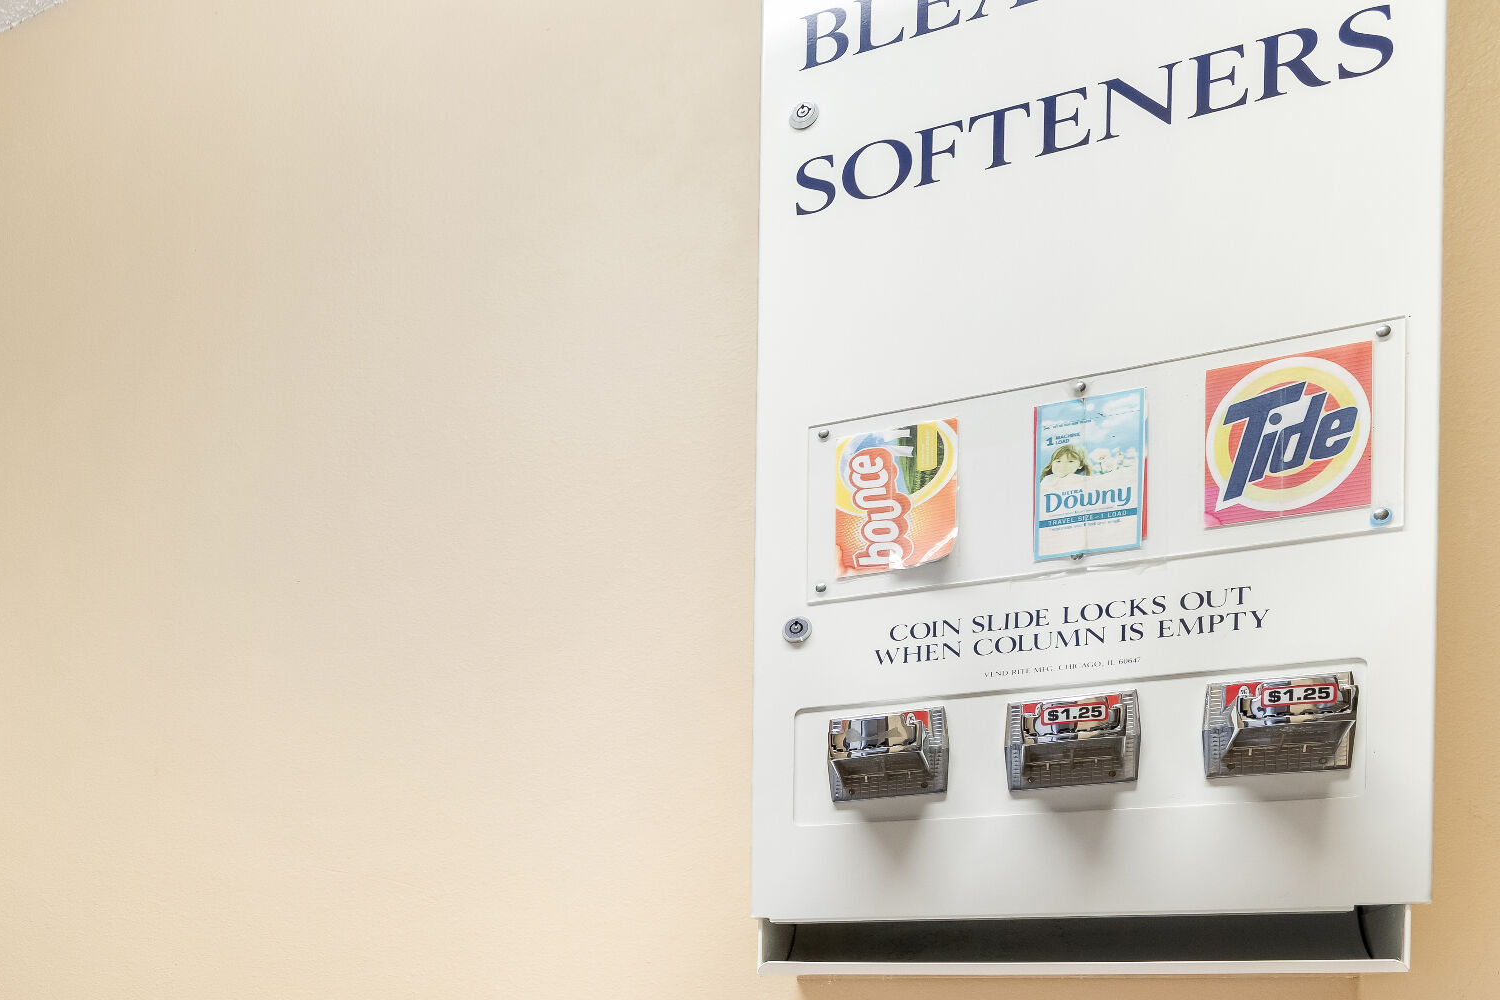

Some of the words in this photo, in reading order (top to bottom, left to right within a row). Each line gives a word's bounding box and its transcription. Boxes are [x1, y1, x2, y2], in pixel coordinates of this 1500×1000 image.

[795, 4, 1395, 216] SOFTENERS
[1046, 436, 1054, 447] 1
[1222, 380, 1359, 503] Tide
[851, 454, 905, 569] bounce
[1043, 486, 1132, 513] Downy
[1048, 516, 1076, 526] TRAVEL
[1107, 510, 1127, 518] LOAD
[889, 617, 963, 643] COIN
[972, 608, 1050, 634] SLIDE
[1062, 595, 1167, 625] LOCKS
[1179, 585, 1252, 612] OUT
[874, 639, 962, 666] WHEN
[973, 626, 1108, 657] COLUMN
[1120, 621, 1144, 643] IS
[1157, 608, 1271, 639] EMPTY
[983, 670, 1009, 679] VEND
[1011, 667, 1030, 676] RITE
[1267, 686, 1331, 704] $1.25
[1047, 705, 1103, 722] $1.25
